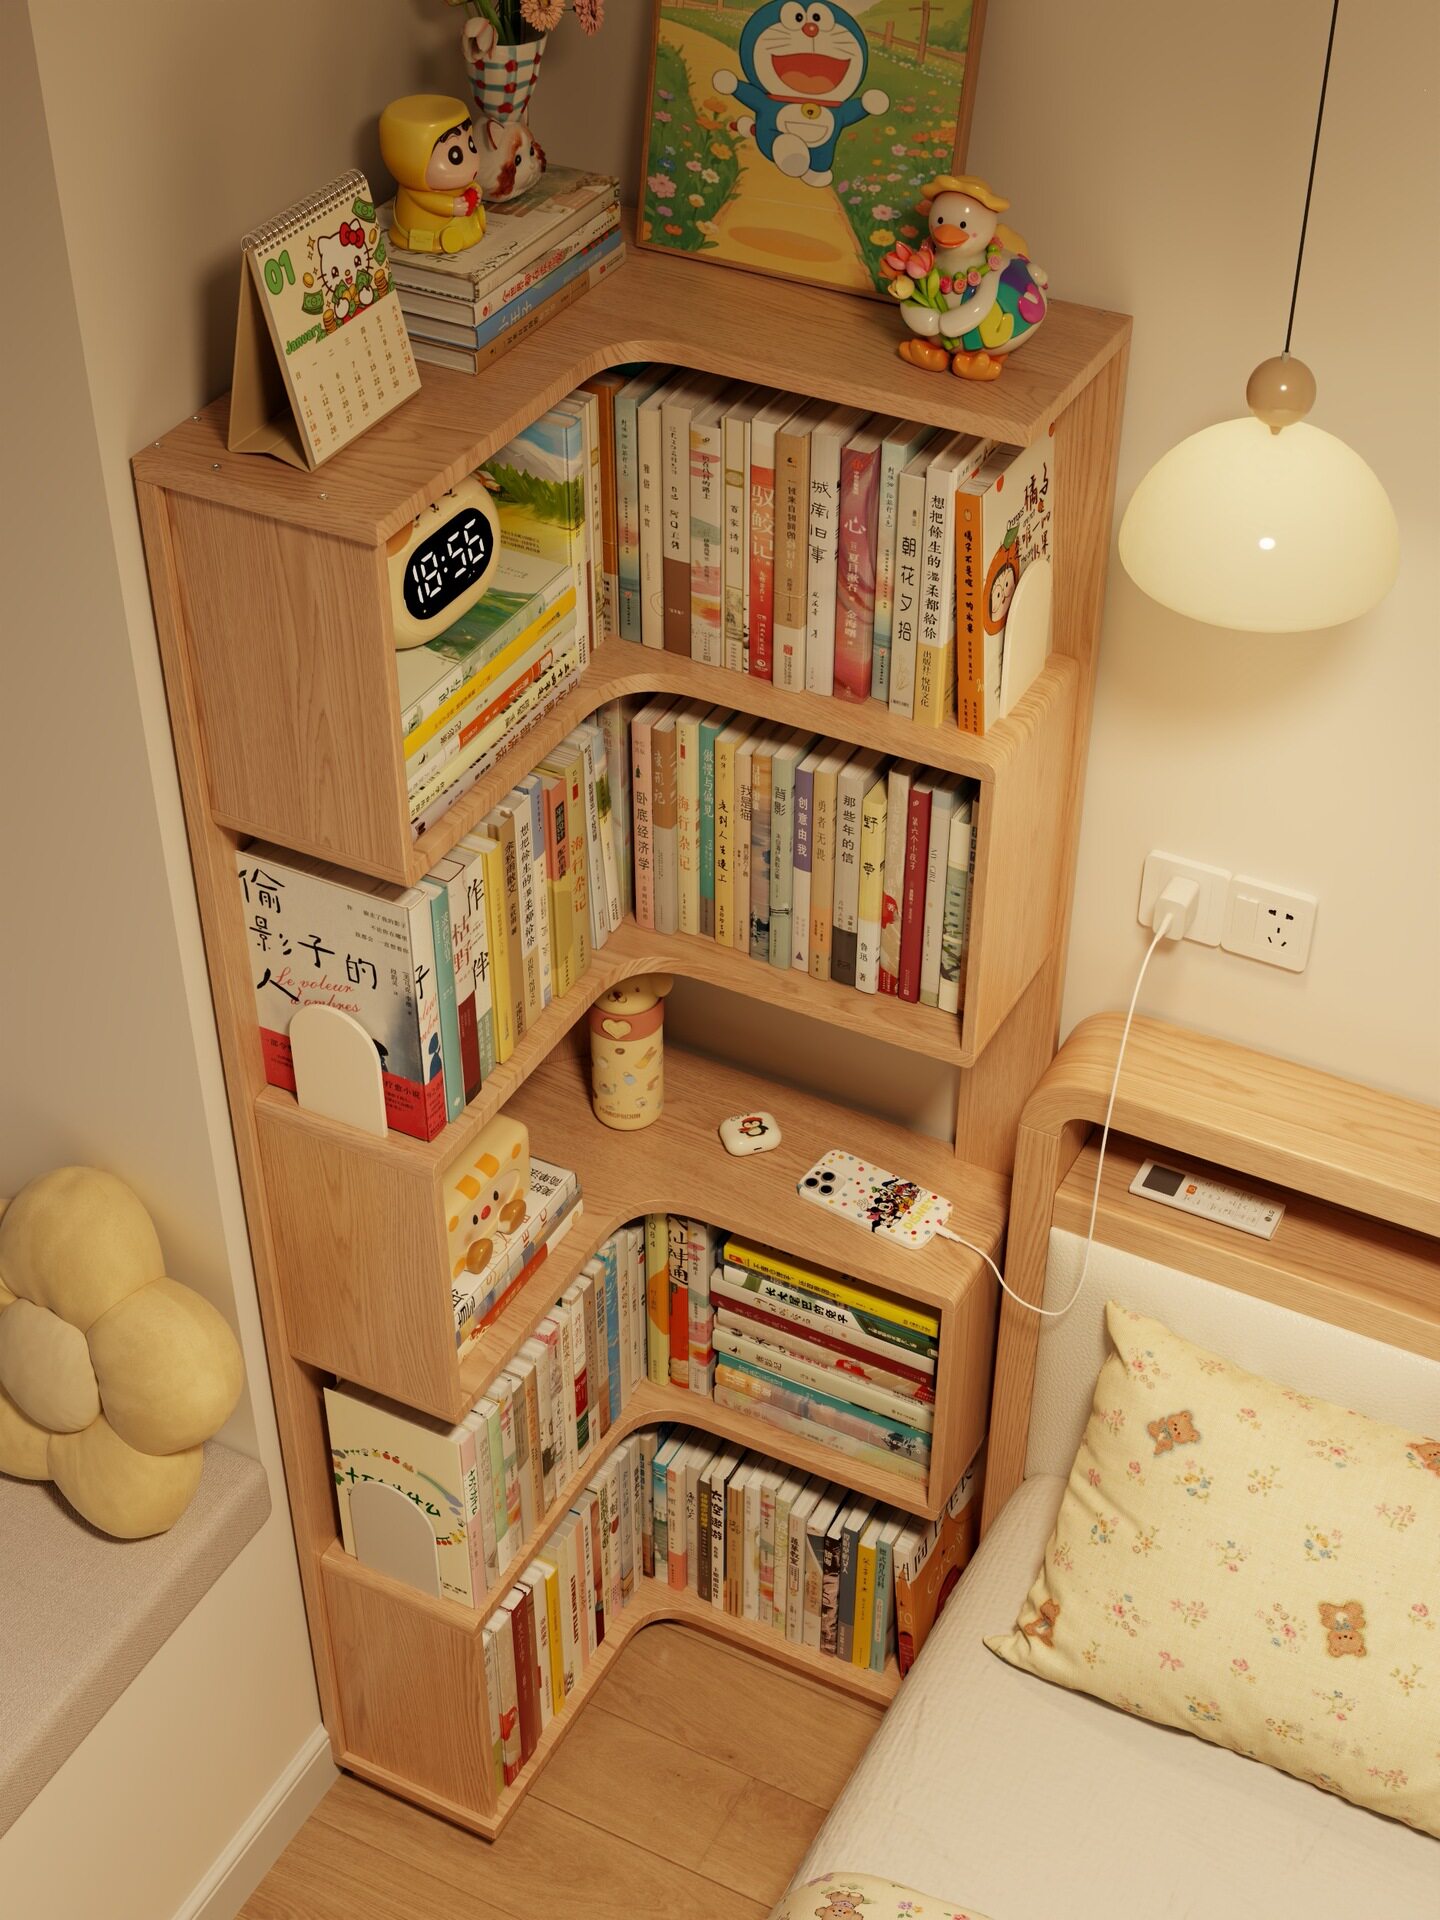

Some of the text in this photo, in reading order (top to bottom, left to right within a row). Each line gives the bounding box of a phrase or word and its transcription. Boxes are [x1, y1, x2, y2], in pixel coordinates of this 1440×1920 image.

[264, 250, 295, 295] 01
[286, 323, 322, 355] January
[751, 484, 776, 562] 驭鲛记
[809, 479, 832, 565] 城南旧事
[844, 516, 867, 537] 心
[412, 518, 486, 604] 18:56
[897, 534, 918, 643] 朝花夕拾
[653, 750, 666, 806] 变形记
[703, 750, 714, 818] 傲慢与偏见
[740, 784, 752, 822] 我是猫
[775, 786, 787, 817] 背影
[636, 790, 650, 870] 卧底经济学
[677, 795, 692, 871] 海行杂记
[797, 796, 809, 857] 创意由我
[816, 799, 827, 863] 勇者无畏
[841, 794, 857, 866] 那些年的信
[238, 867, 286, 914] 偷
[571, 836, 587, 911] 海行杂记
[249, 915, 378, 991] 影子的
[858, 941, 869, 983] 鲁迅 著
[256, 967, 301, 1003] 人
[276, 966, 355, 994] Le voleur
[415, 964, 432, 1001] 子
[649, 1220, 657, 1248] Q84
[1267, 1208, 1275, 1219] LG
[764, 1286, 848, 1324] 长大尾巴的兔子
[711, 1489, 724, 1541] 太空遨游
